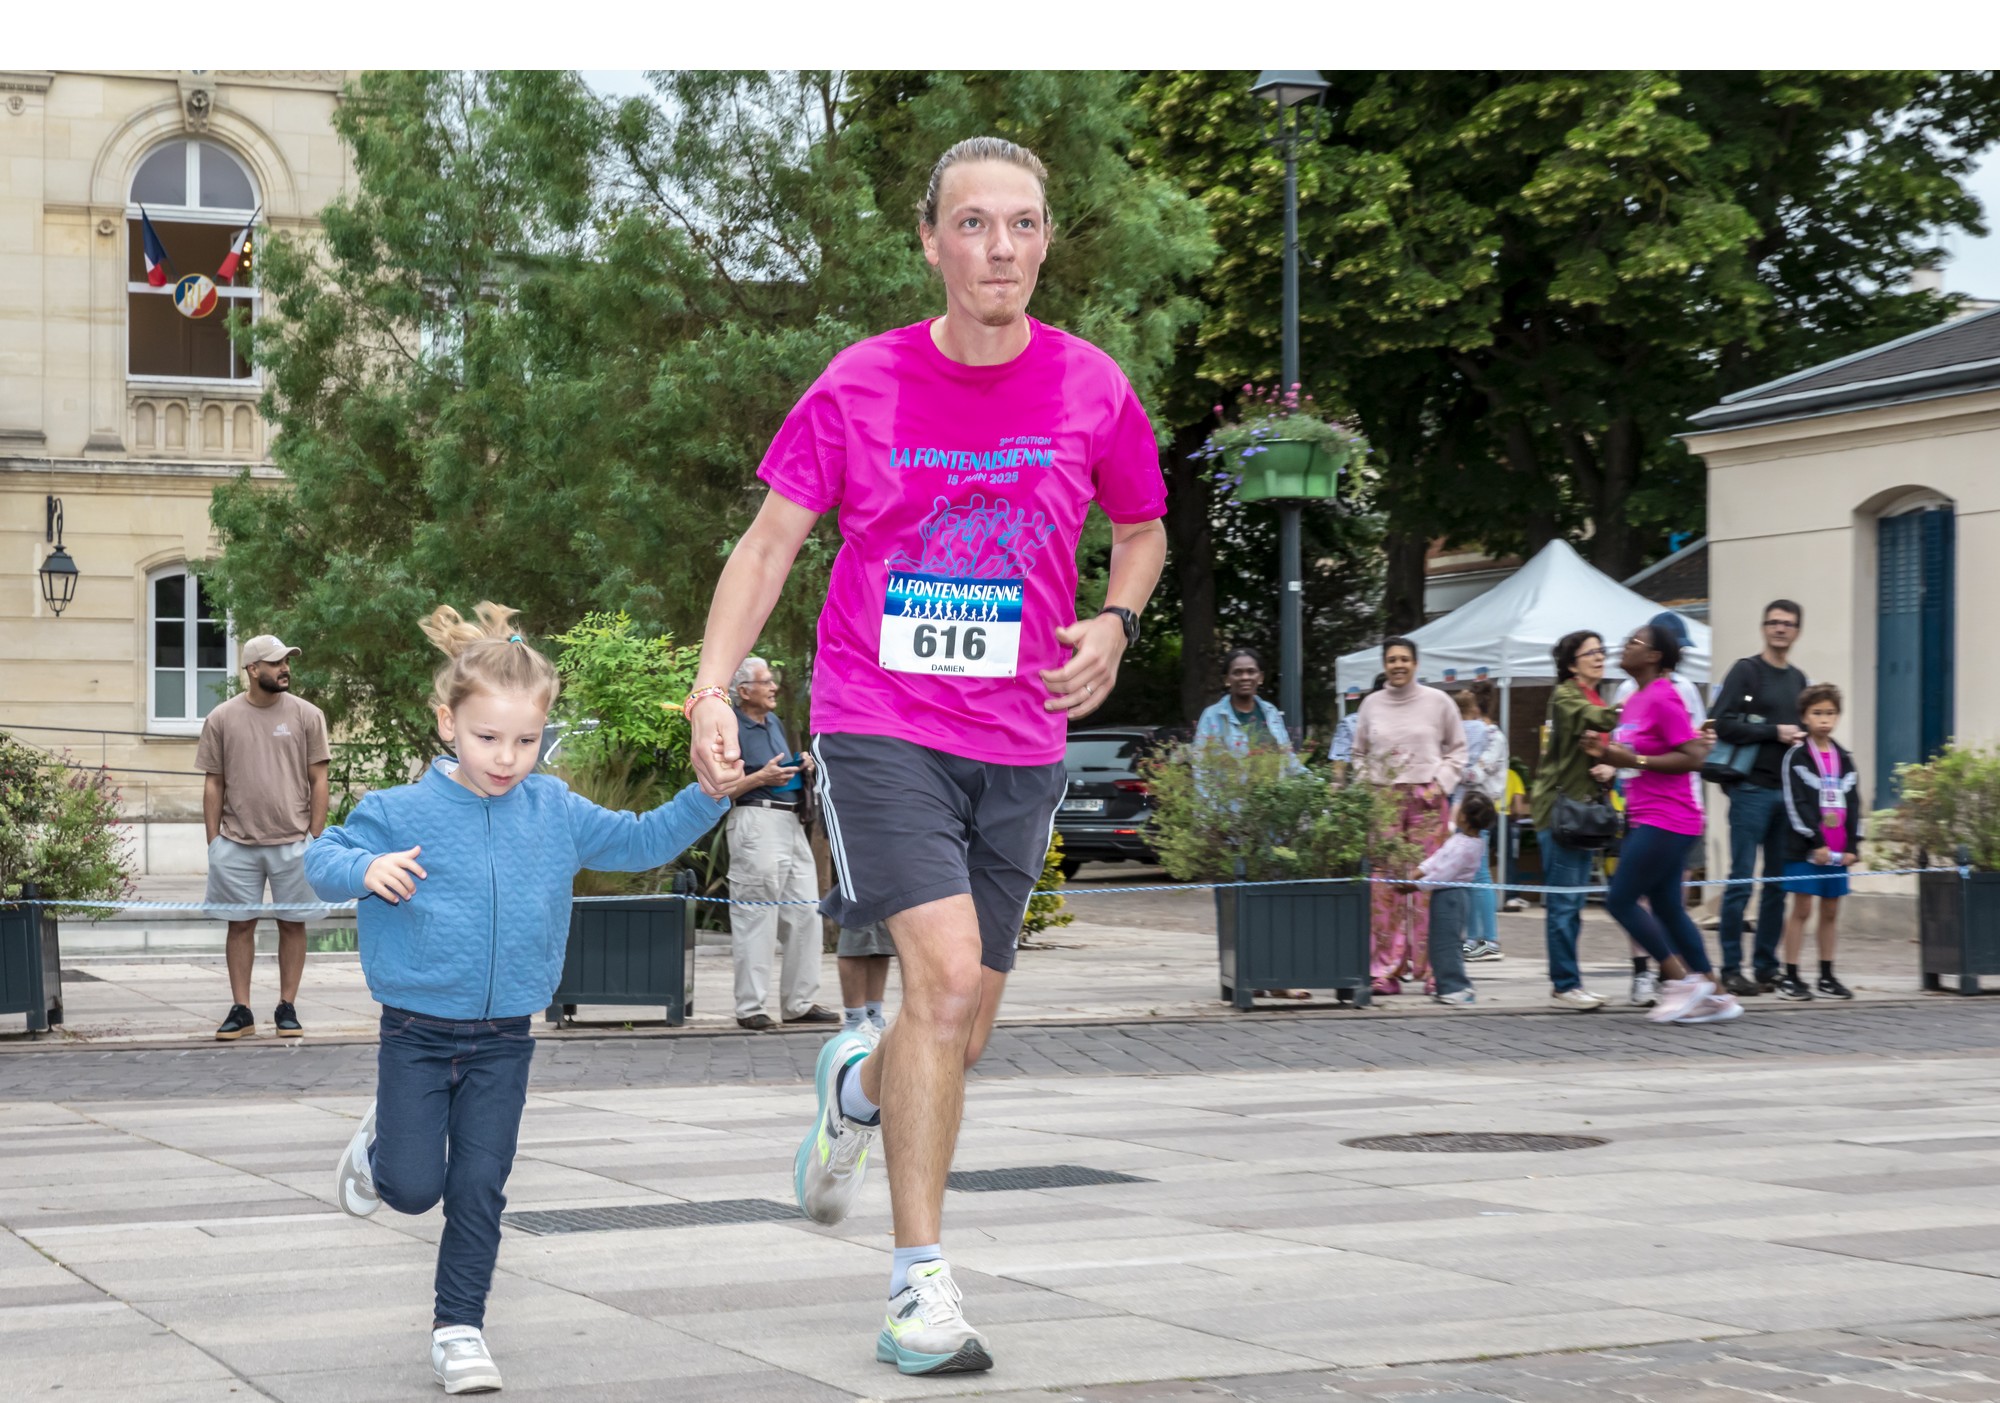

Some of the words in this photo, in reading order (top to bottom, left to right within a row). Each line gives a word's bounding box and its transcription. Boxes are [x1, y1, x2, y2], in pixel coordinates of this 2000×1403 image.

[890, 447, 910, 468] LA
[913, 447, 1056, 471] FONTENAISIENNE
[947, 473, 959, 486] 15
[989, 471, 1019, 484] 2025
[888, 577, 904, 594] LA
[905, 579, 1022, 601] FONTENAISIENNE
[913, 623, 987, 661] 616
[931, 663, 965, 673] DAMIEN
